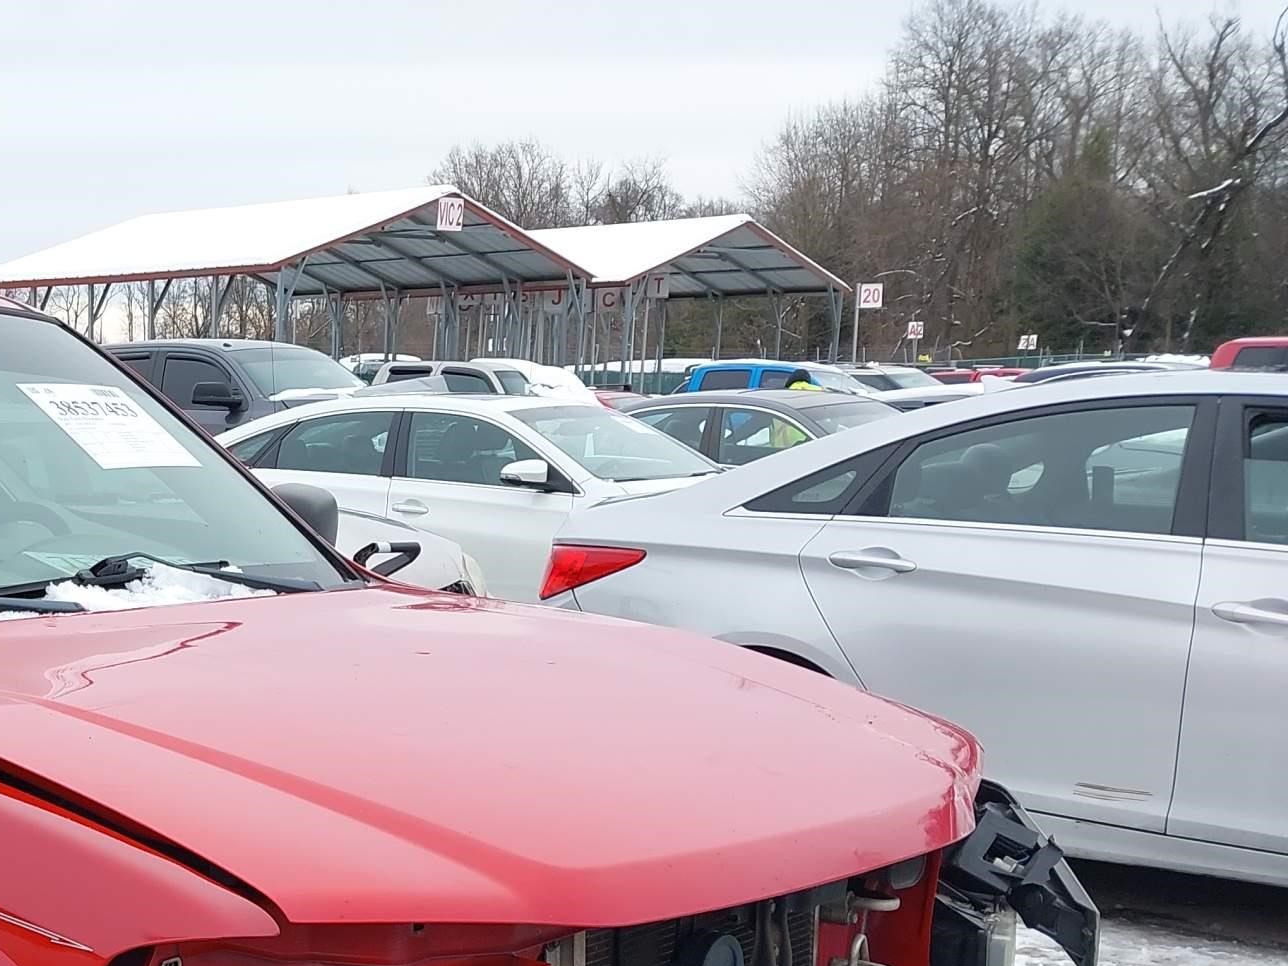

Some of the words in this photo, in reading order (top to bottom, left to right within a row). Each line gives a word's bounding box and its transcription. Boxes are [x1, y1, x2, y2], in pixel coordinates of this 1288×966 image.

[456, 203, 463, 227] 2
[862, 288, 880, 303] 20
[49, 400, 138, 417] 38537453
